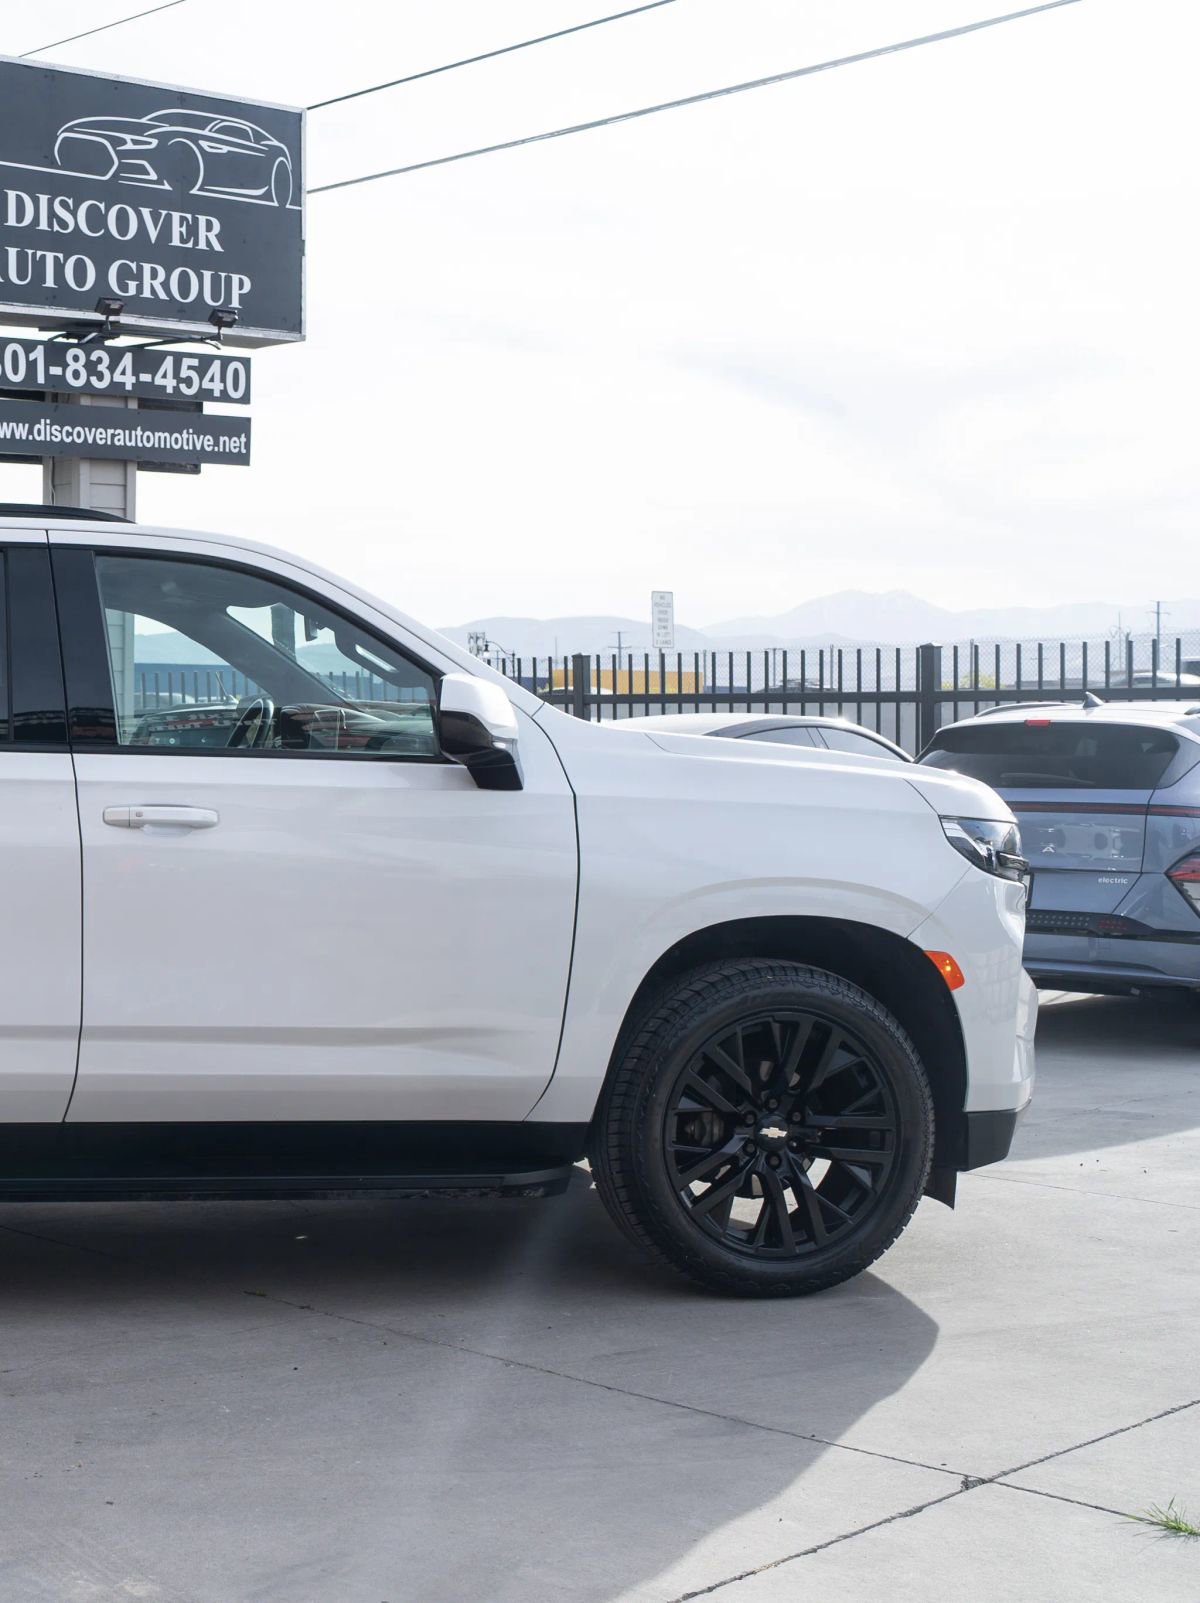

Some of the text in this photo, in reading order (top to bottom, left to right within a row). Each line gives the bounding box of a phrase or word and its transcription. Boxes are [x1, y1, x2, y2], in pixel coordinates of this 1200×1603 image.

[3, 189, 224, 252] DISCOVER
[108, 259, 252, 308] GROUP
[1097, 876, 1129, 885] electric
